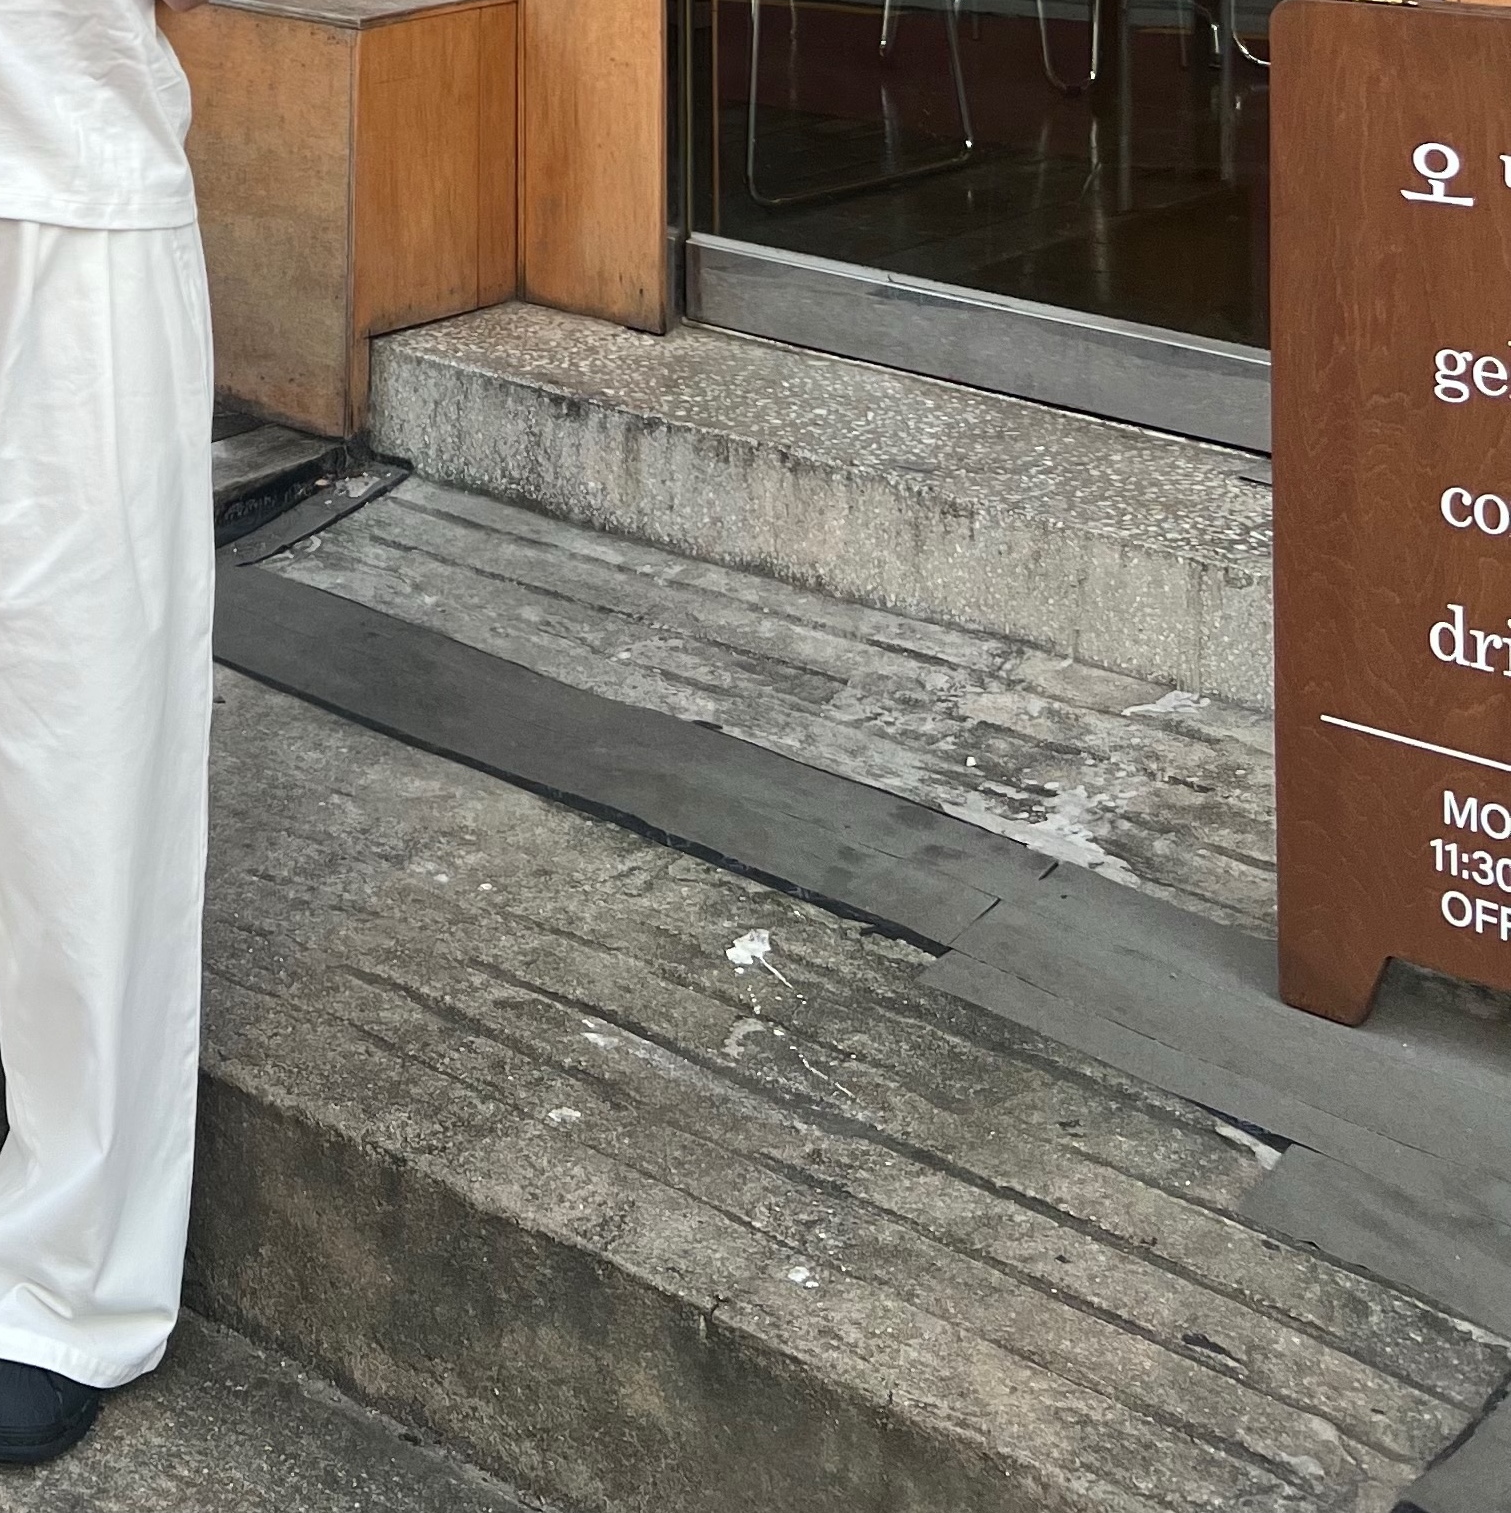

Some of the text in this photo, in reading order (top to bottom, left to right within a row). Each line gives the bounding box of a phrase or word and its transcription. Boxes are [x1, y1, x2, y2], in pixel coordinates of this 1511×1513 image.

[1434, 341, 1511, 403] ge
[1440, 487, 1511, 535] co
[1443, 790, 1511, 840] MO
